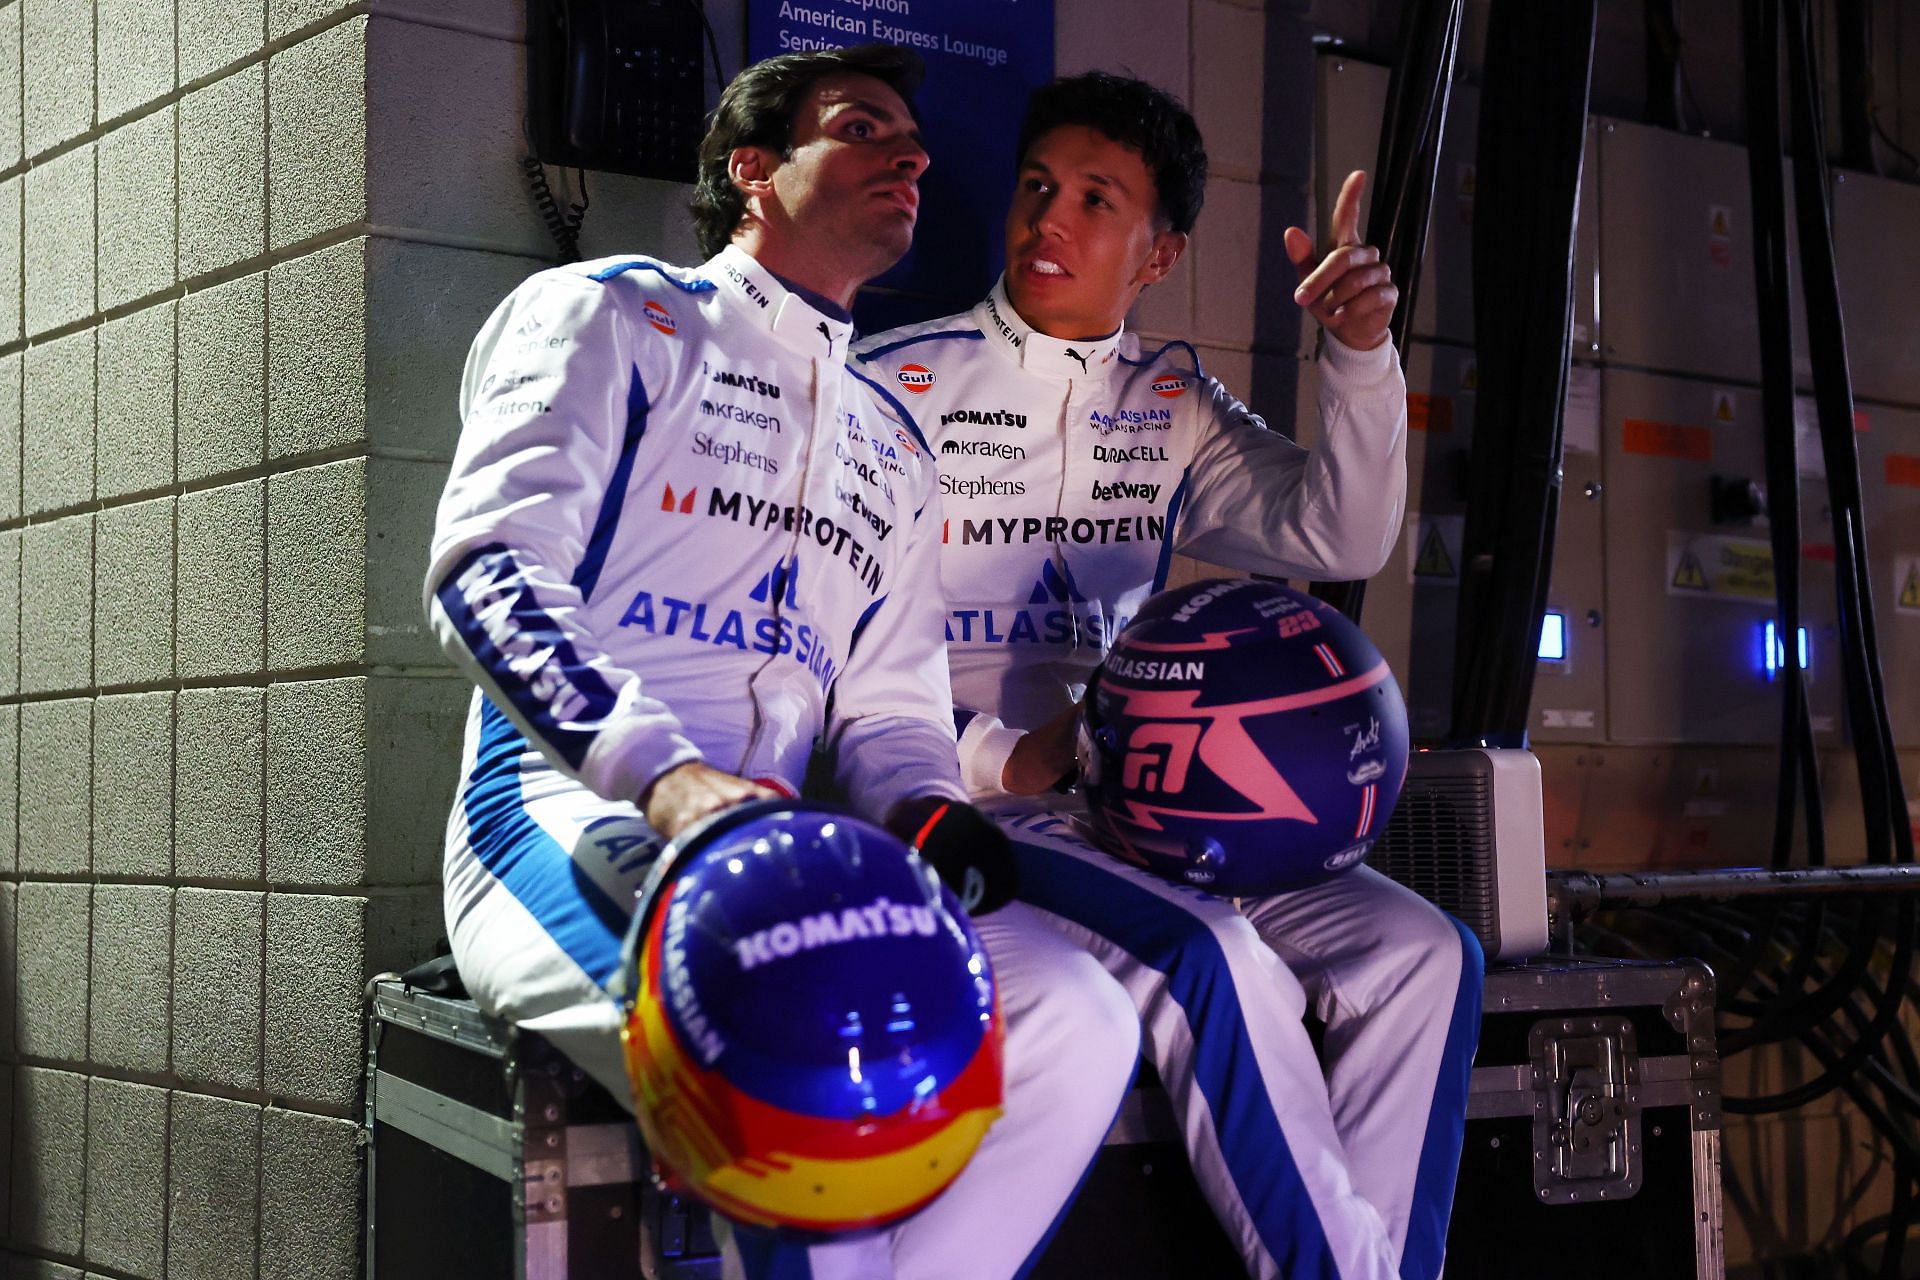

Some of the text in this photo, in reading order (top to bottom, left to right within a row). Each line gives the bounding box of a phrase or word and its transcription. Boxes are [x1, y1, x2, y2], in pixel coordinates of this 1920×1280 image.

[779, 1, 1008, 66] American Express Lounge
[643, 307, 676, 328] Gulf
[897, 371, 935, 383] Gulf
[1151, 380, 1187, 391] Gulf
[716, 403, 781, 433] kraken
[941, 410, 1027, 429] KOMATSU
[692, 432, 778, 475] Stephens
[961, 440, 1026, 460] kraken
[1093, 445, 1169, 463] DURACELL
[939, 474, 1026, 498] Stephens
[1091, 480, 1161, 504] betway
[835, 478, 894, 542] betway
[707, 486, 884, 596] MYPROTEIN
[962, 516, 1165, 545] MYPROTEIN
[1278, 610, 1322, 638] 23
[618, 591, 836, 697] ATLASSIAN
[736, 897, 937, 970] KOMATSU
